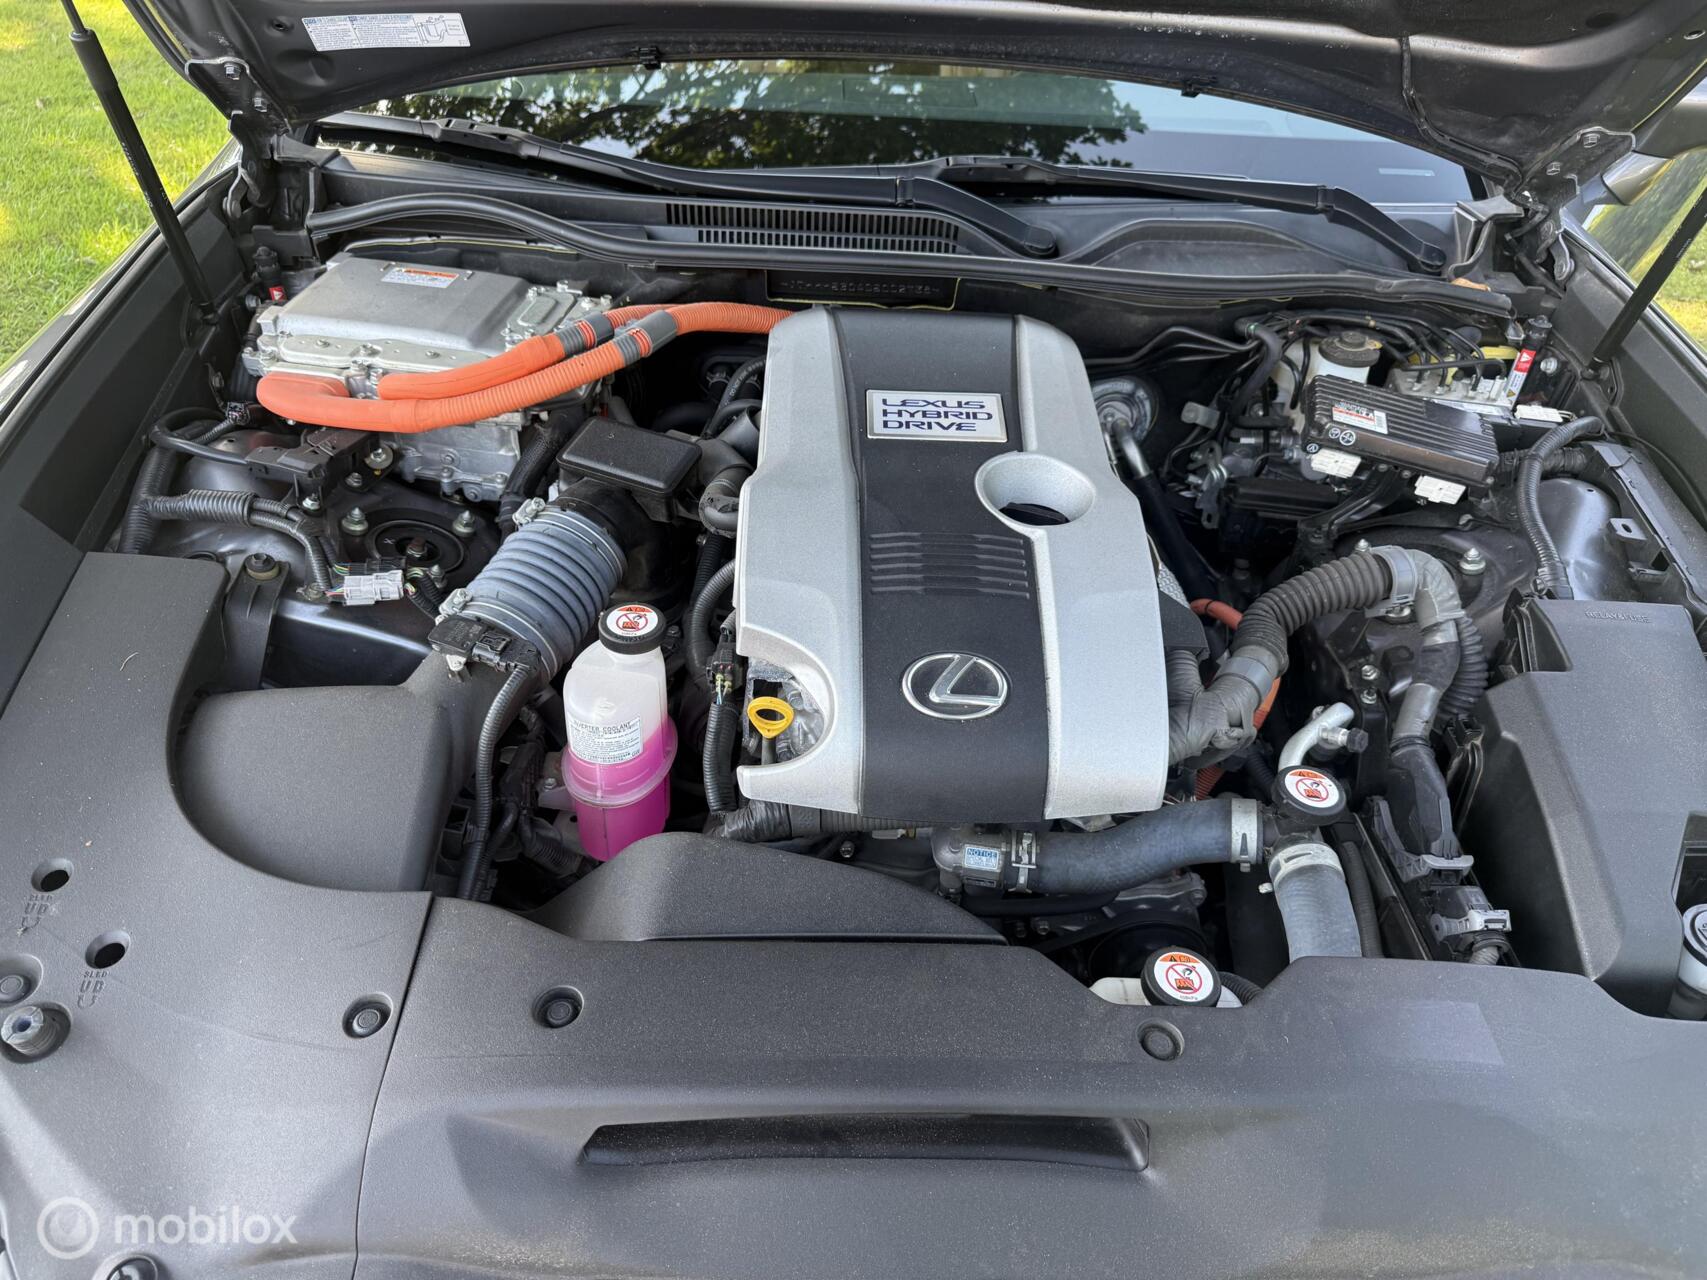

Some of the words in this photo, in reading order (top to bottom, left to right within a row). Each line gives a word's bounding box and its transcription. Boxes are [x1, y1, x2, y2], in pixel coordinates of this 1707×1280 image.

[881, 398, 986, 410] LEXUS
[882, 409, 993, 420] HYBRID
[882, 420, 977, 431] DRIVE
[602, 721, 632, 731] COOLANT
[967, 848, 998, 858] NOTICE
